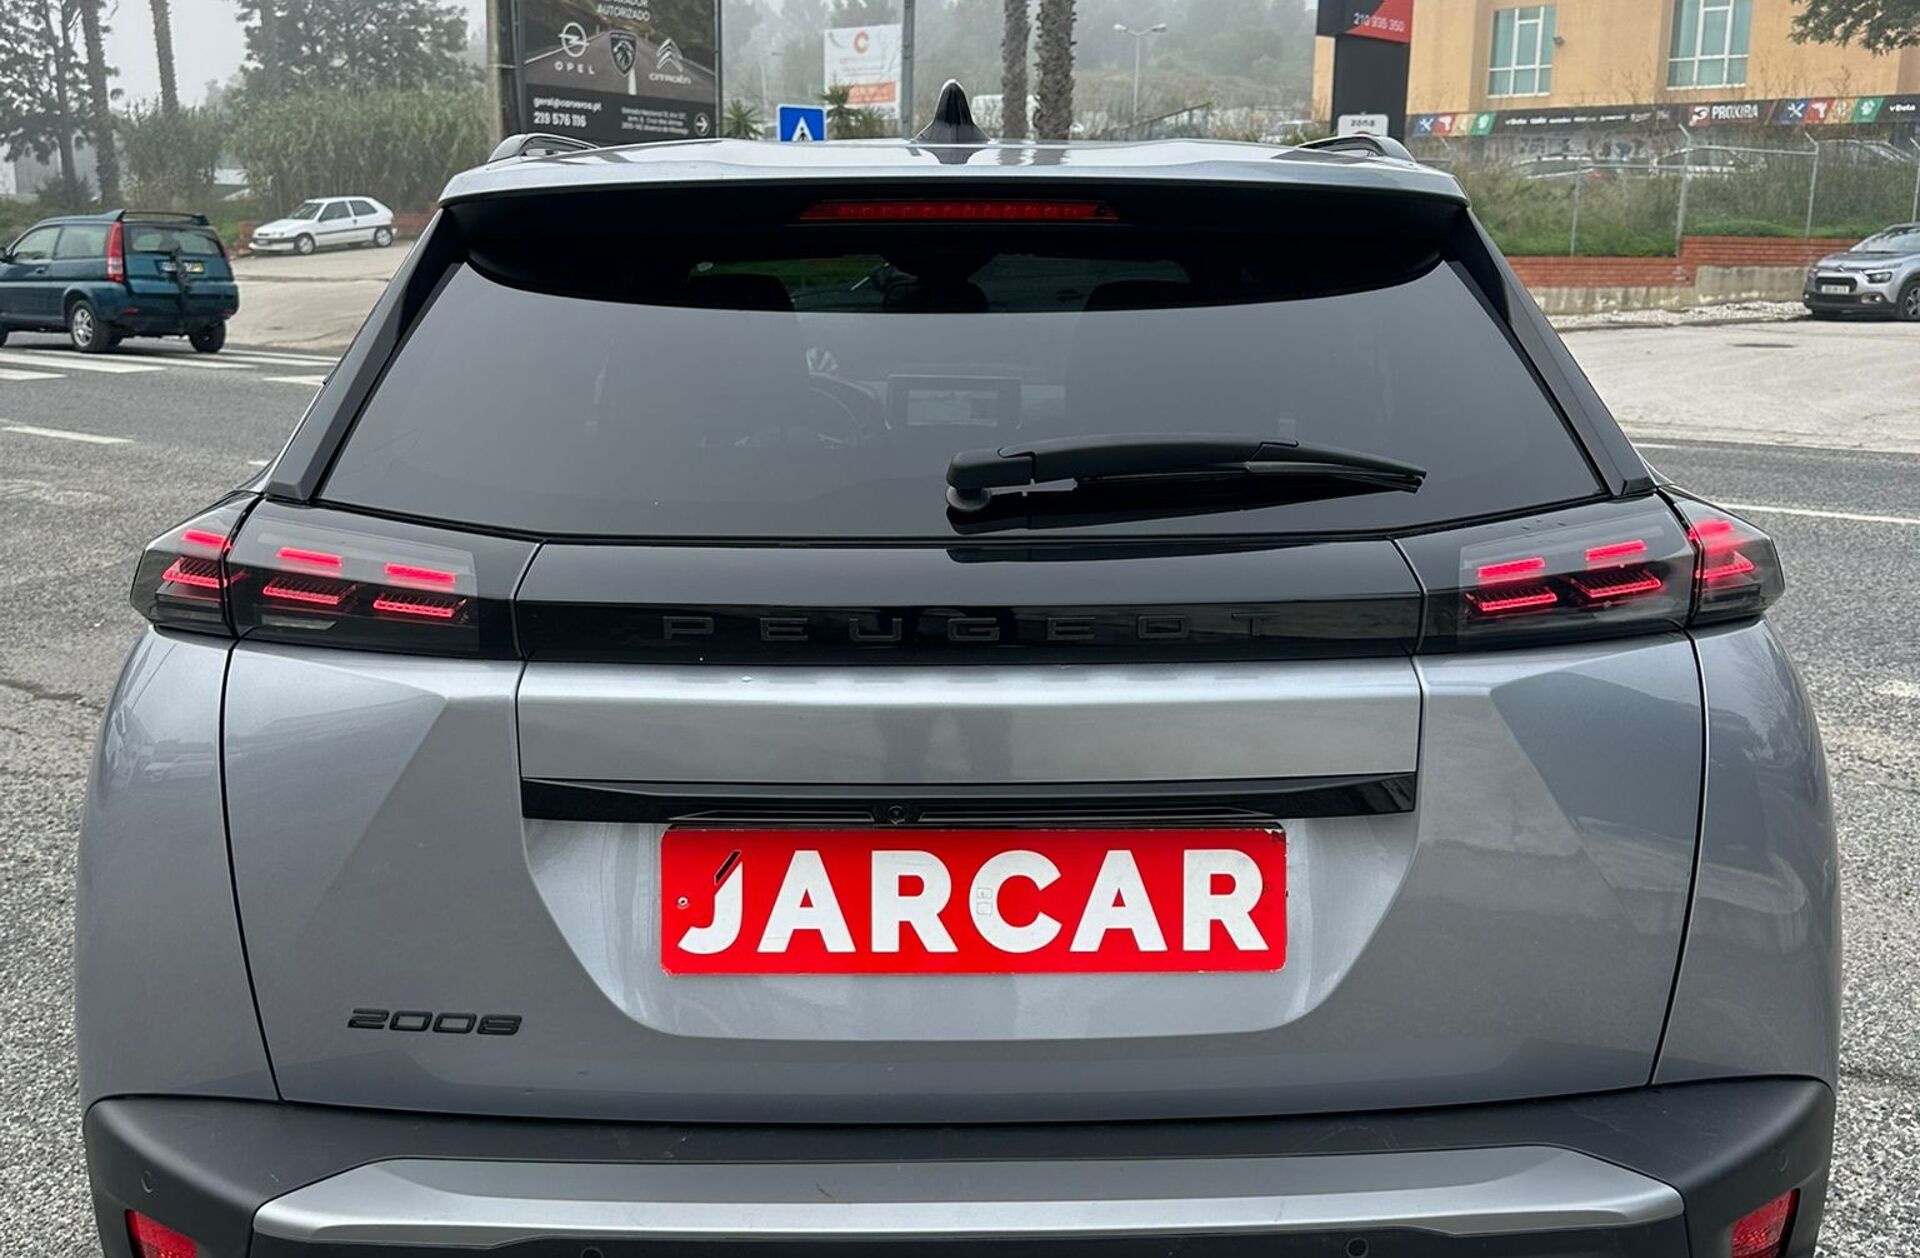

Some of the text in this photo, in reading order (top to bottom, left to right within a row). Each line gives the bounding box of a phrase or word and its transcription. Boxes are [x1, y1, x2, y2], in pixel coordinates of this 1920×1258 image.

[554, 60, 596, 76] OPEL
[662, 612, 1280, 641] PEUGEOT
[677, 848, 1270, 954] JARCAR
[347, 1007, 523, 1036] 2008
